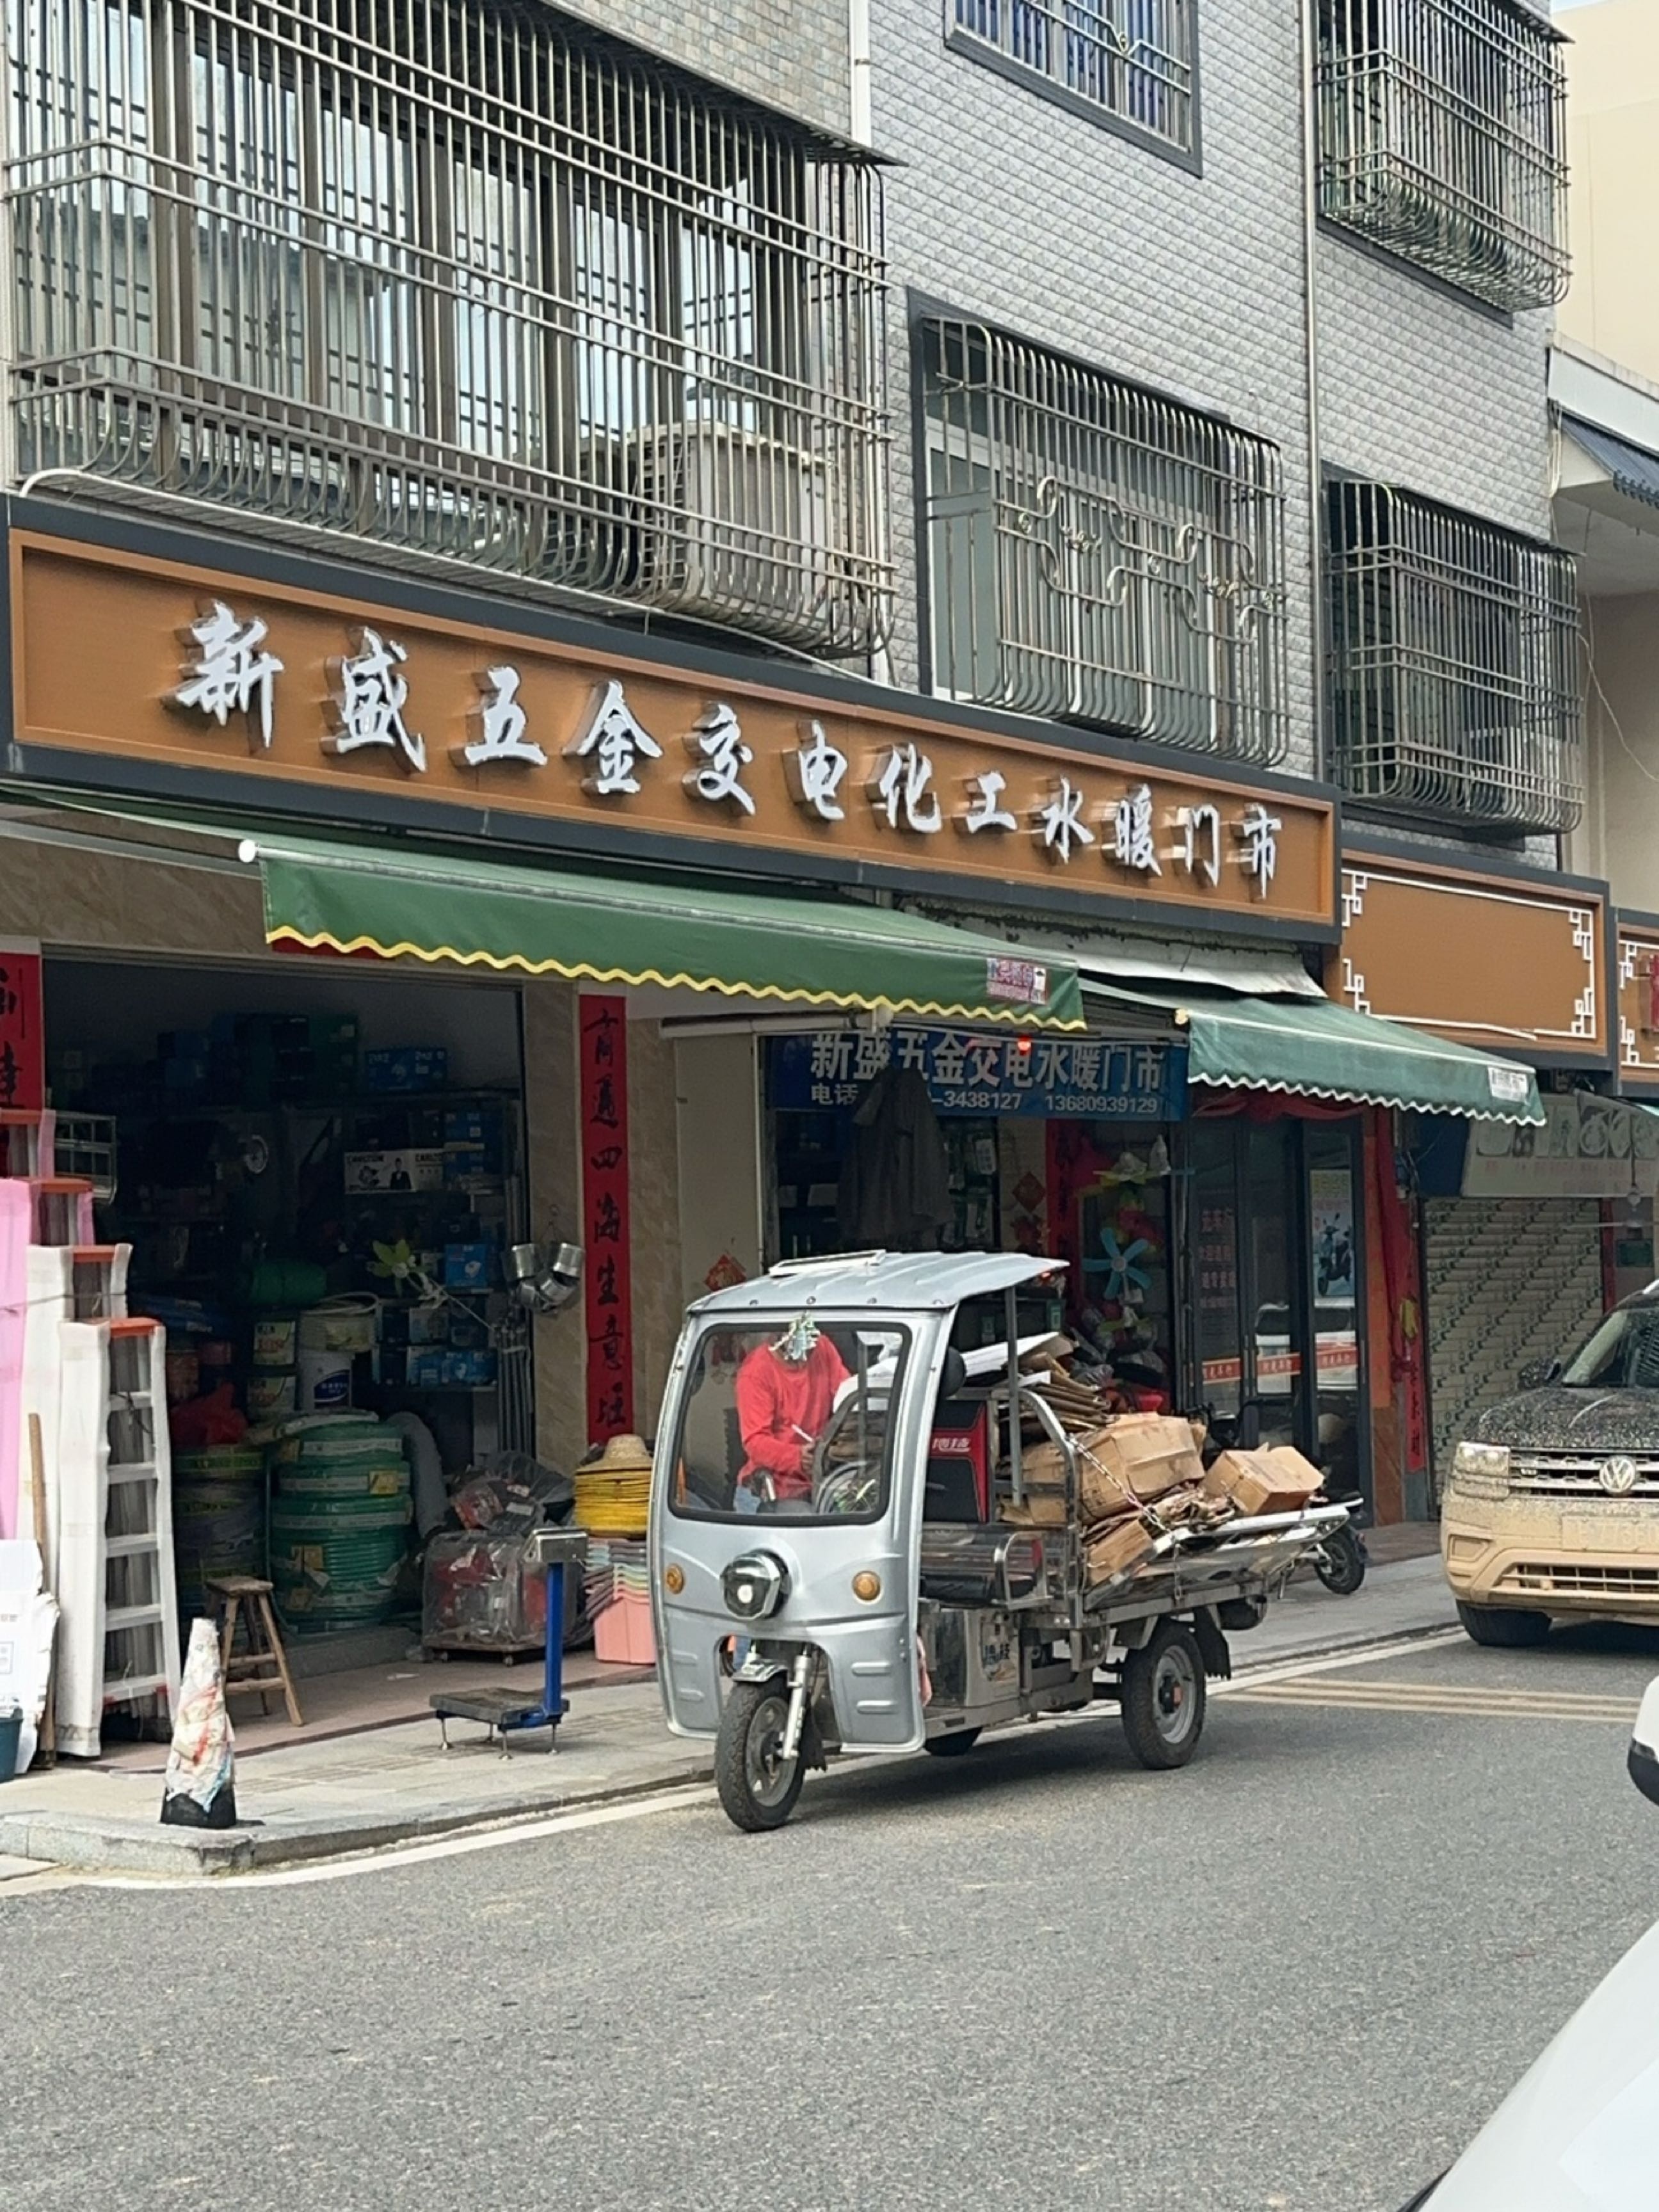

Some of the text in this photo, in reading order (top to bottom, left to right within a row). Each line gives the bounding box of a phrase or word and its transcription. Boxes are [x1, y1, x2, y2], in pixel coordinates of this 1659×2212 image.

[175, 599, 1281, 898] 新盛五金交电化工水暖门市
[810, 1030, 1166, 1093] 新盛五金交电水暖门市
[811, 1082, 1158, 1114] 电话 -3438127 13680939129
